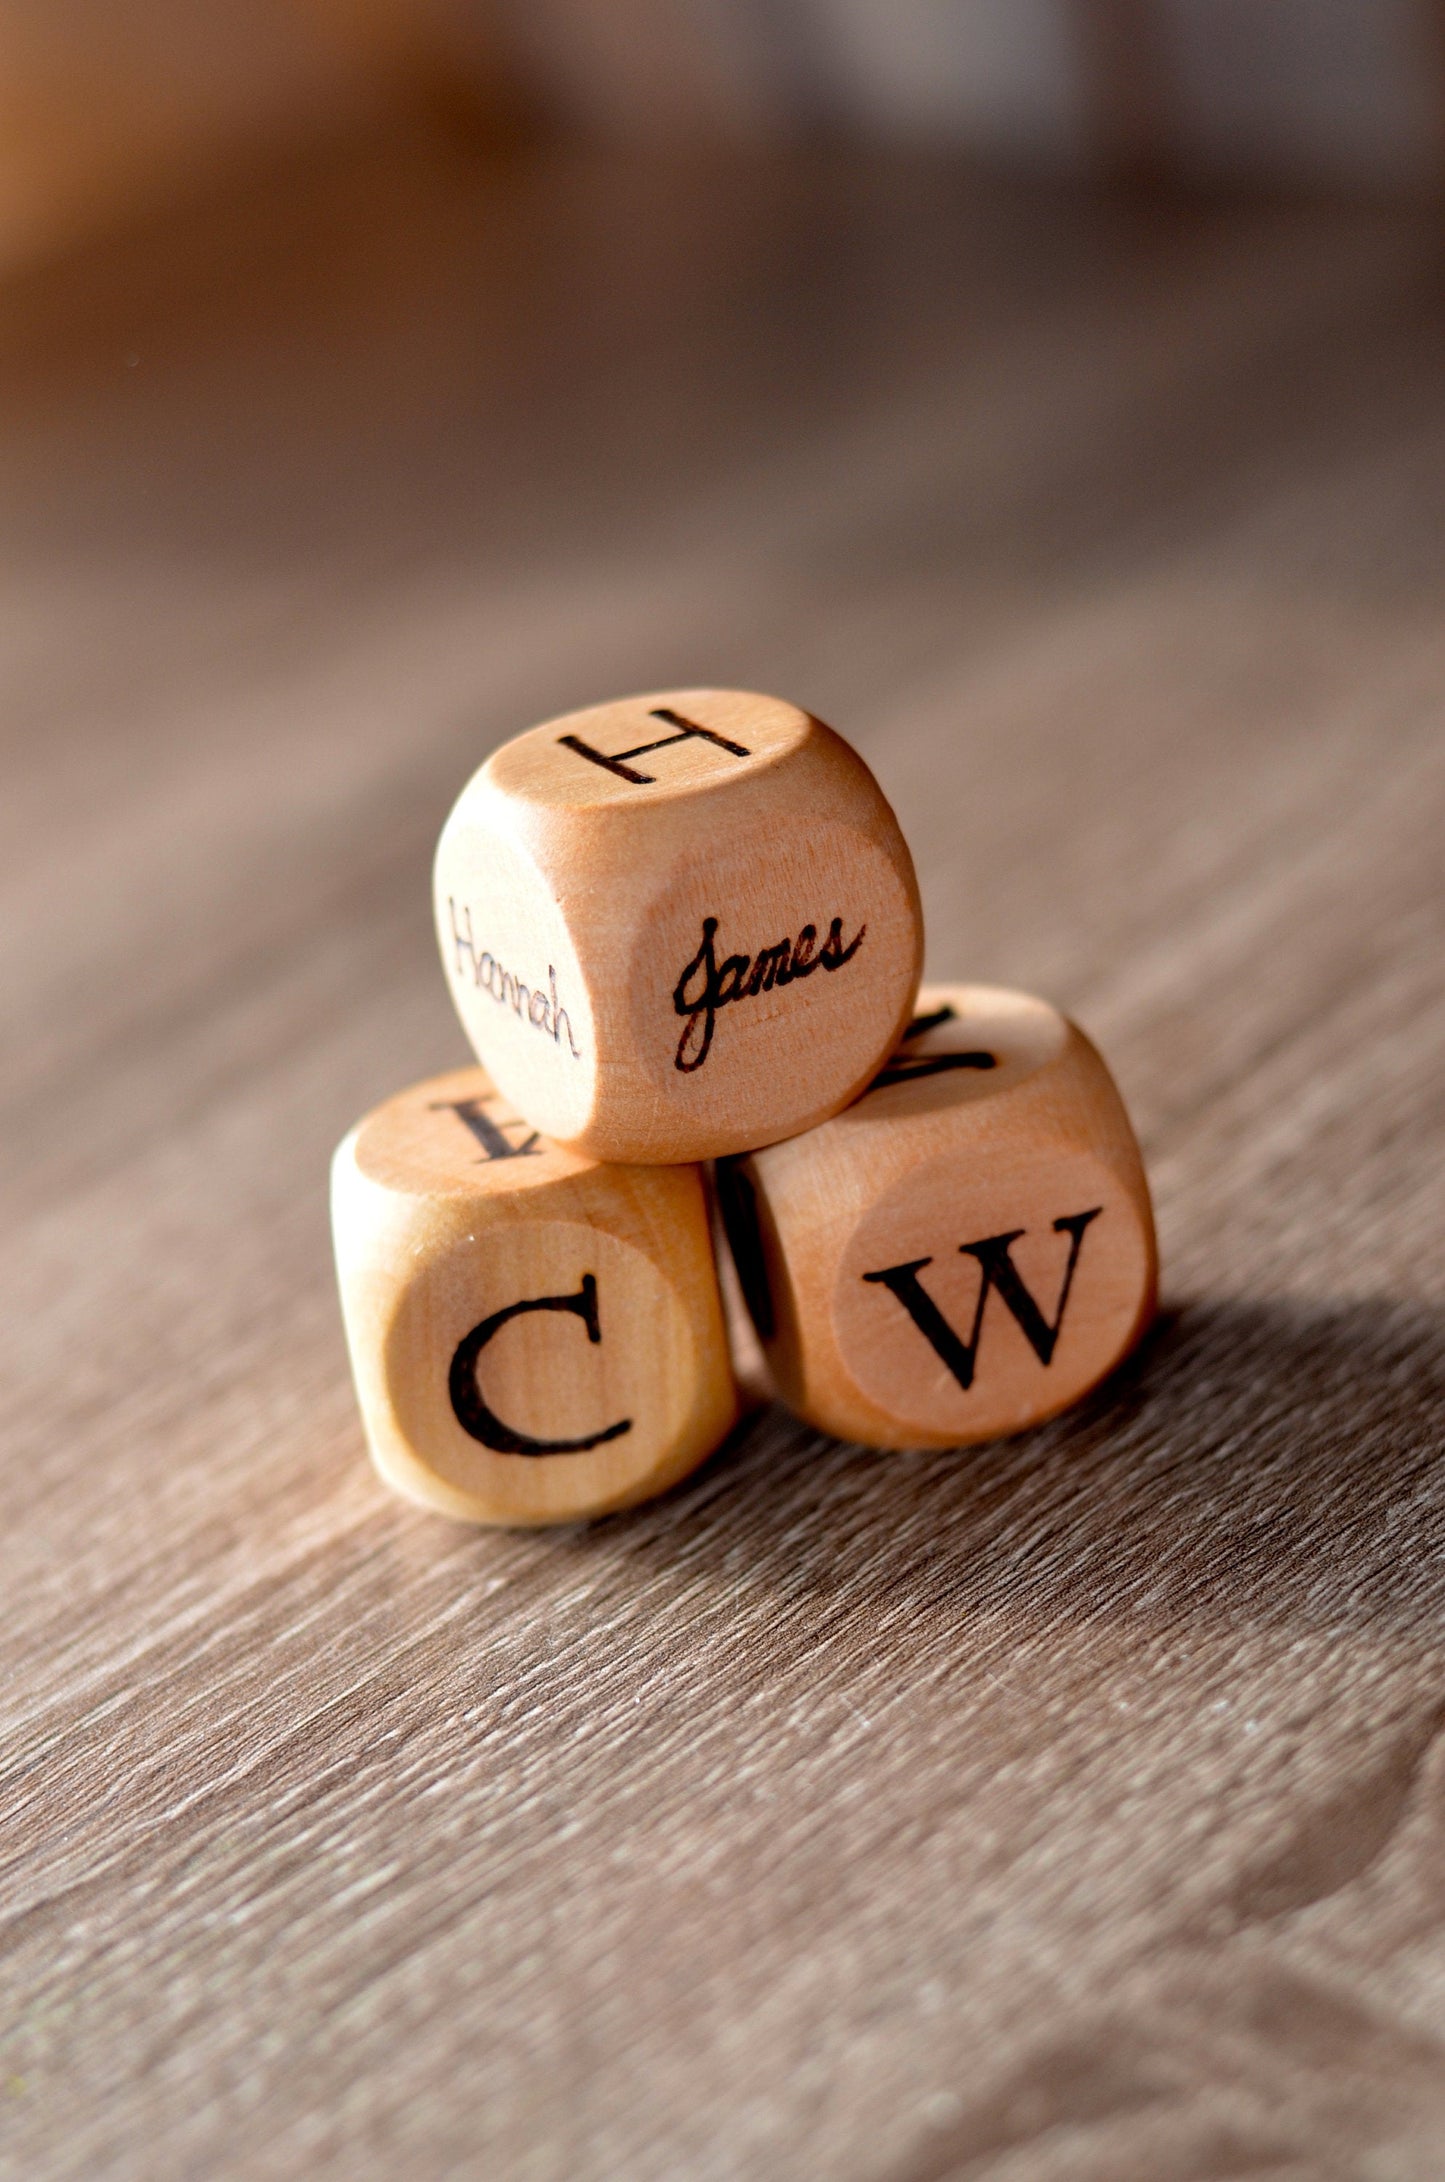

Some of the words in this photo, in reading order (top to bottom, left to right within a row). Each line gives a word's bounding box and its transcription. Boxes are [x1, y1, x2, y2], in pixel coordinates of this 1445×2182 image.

[557, 708, 751, 785] H
[448, 895, 580, 1061] Hannah
[673, 916, 866, 1073] James
[449, 1273, 631, 1456] C
[863, 1206, 1104, 1391] W
